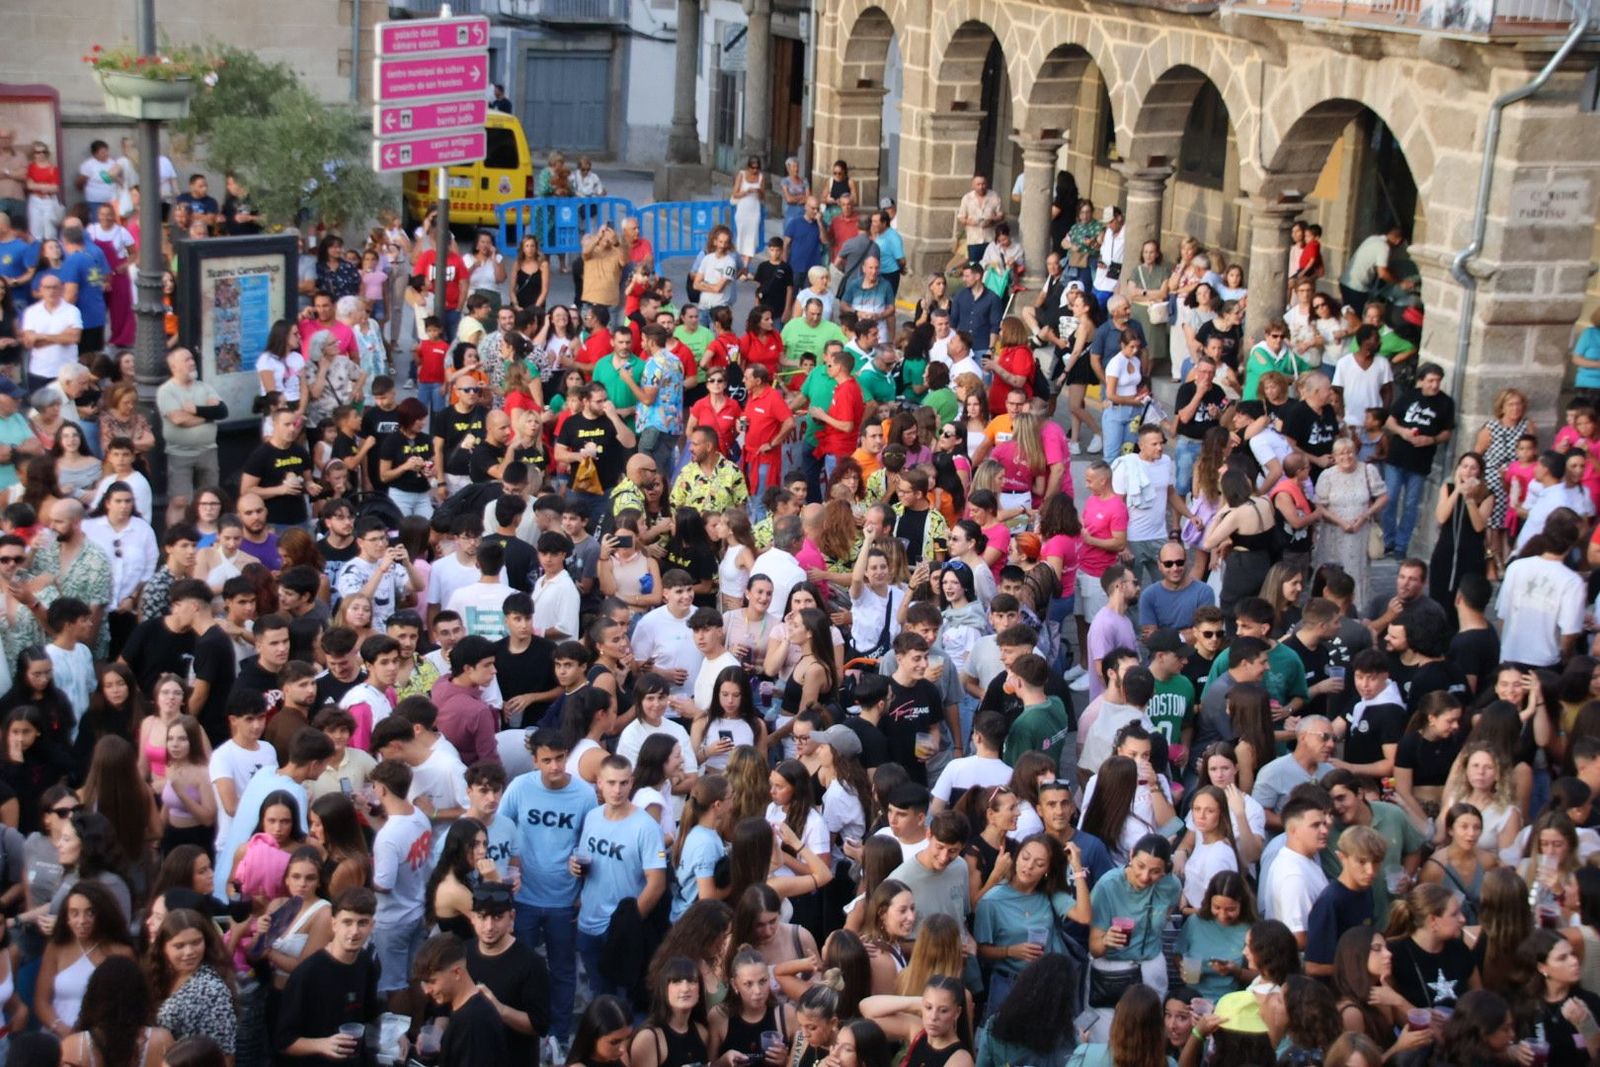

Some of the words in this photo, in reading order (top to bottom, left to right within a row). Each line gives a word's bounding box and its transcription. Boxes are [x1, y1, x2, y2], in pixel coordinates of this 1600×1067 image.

[1145, 693, 1186, 718] BOSTON
[527, 808, 576, 829] SCK
[486, 841, 512, 861] CK
[588, 836, 625, 861] SCK
